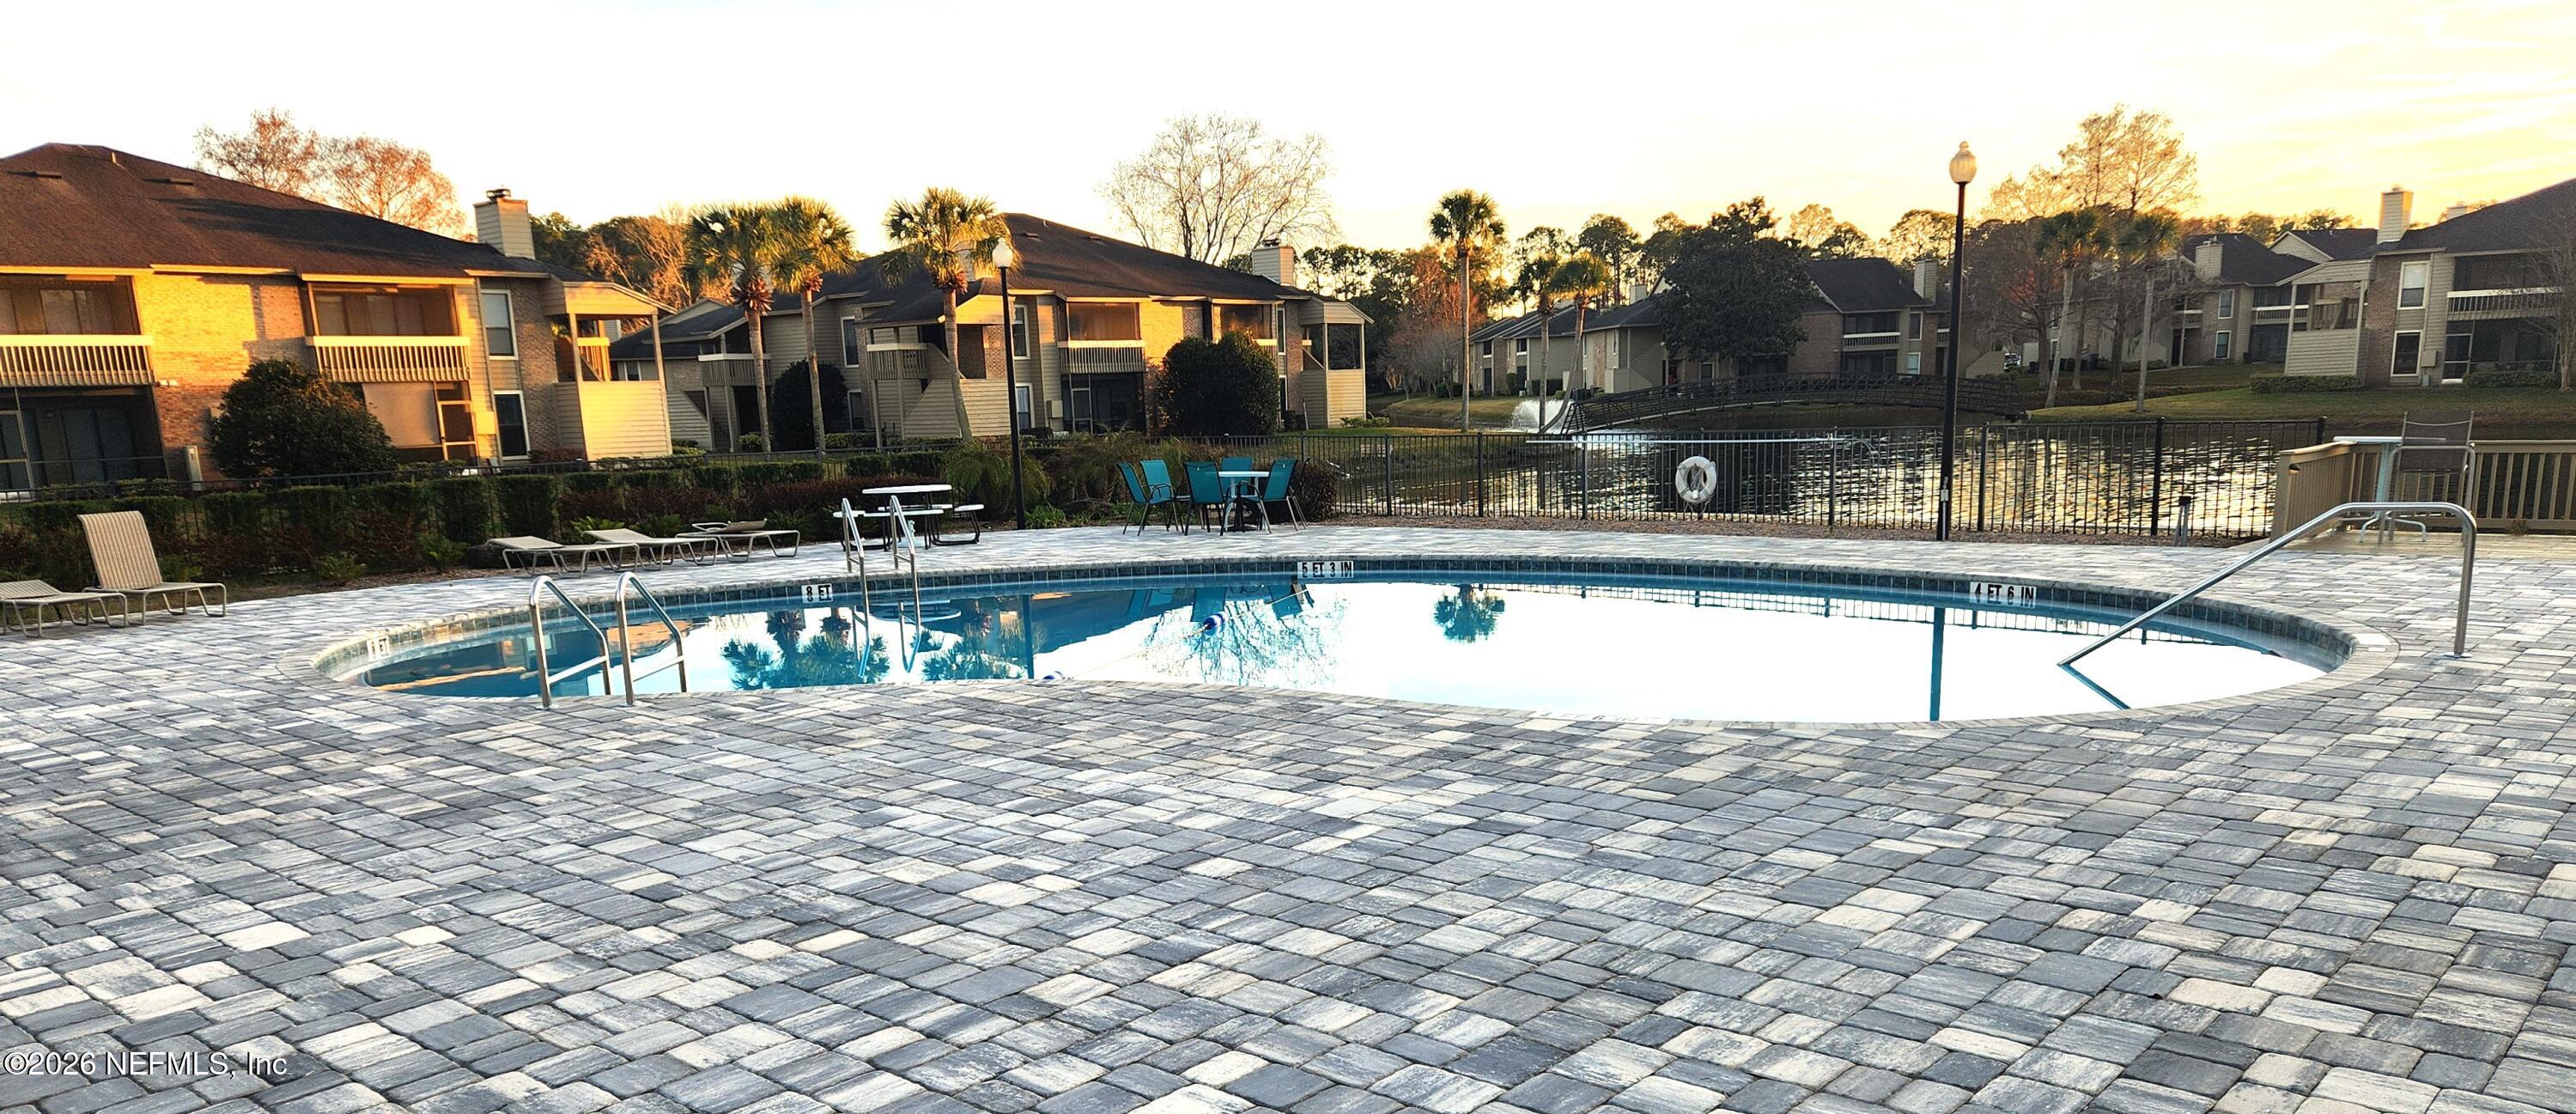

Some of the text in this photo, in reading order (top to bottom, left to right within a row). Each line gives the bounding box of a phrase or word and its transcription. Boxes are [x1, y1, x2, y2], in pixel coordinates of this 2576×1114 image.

[1329, 562, 1336, 577] 3
[1340, 561, 1352, 577] IN
[1975, 582, 1982, 601] 4
[2008, 586, 2014, 603] 6
[2020, 587, 2034, 605] IN
